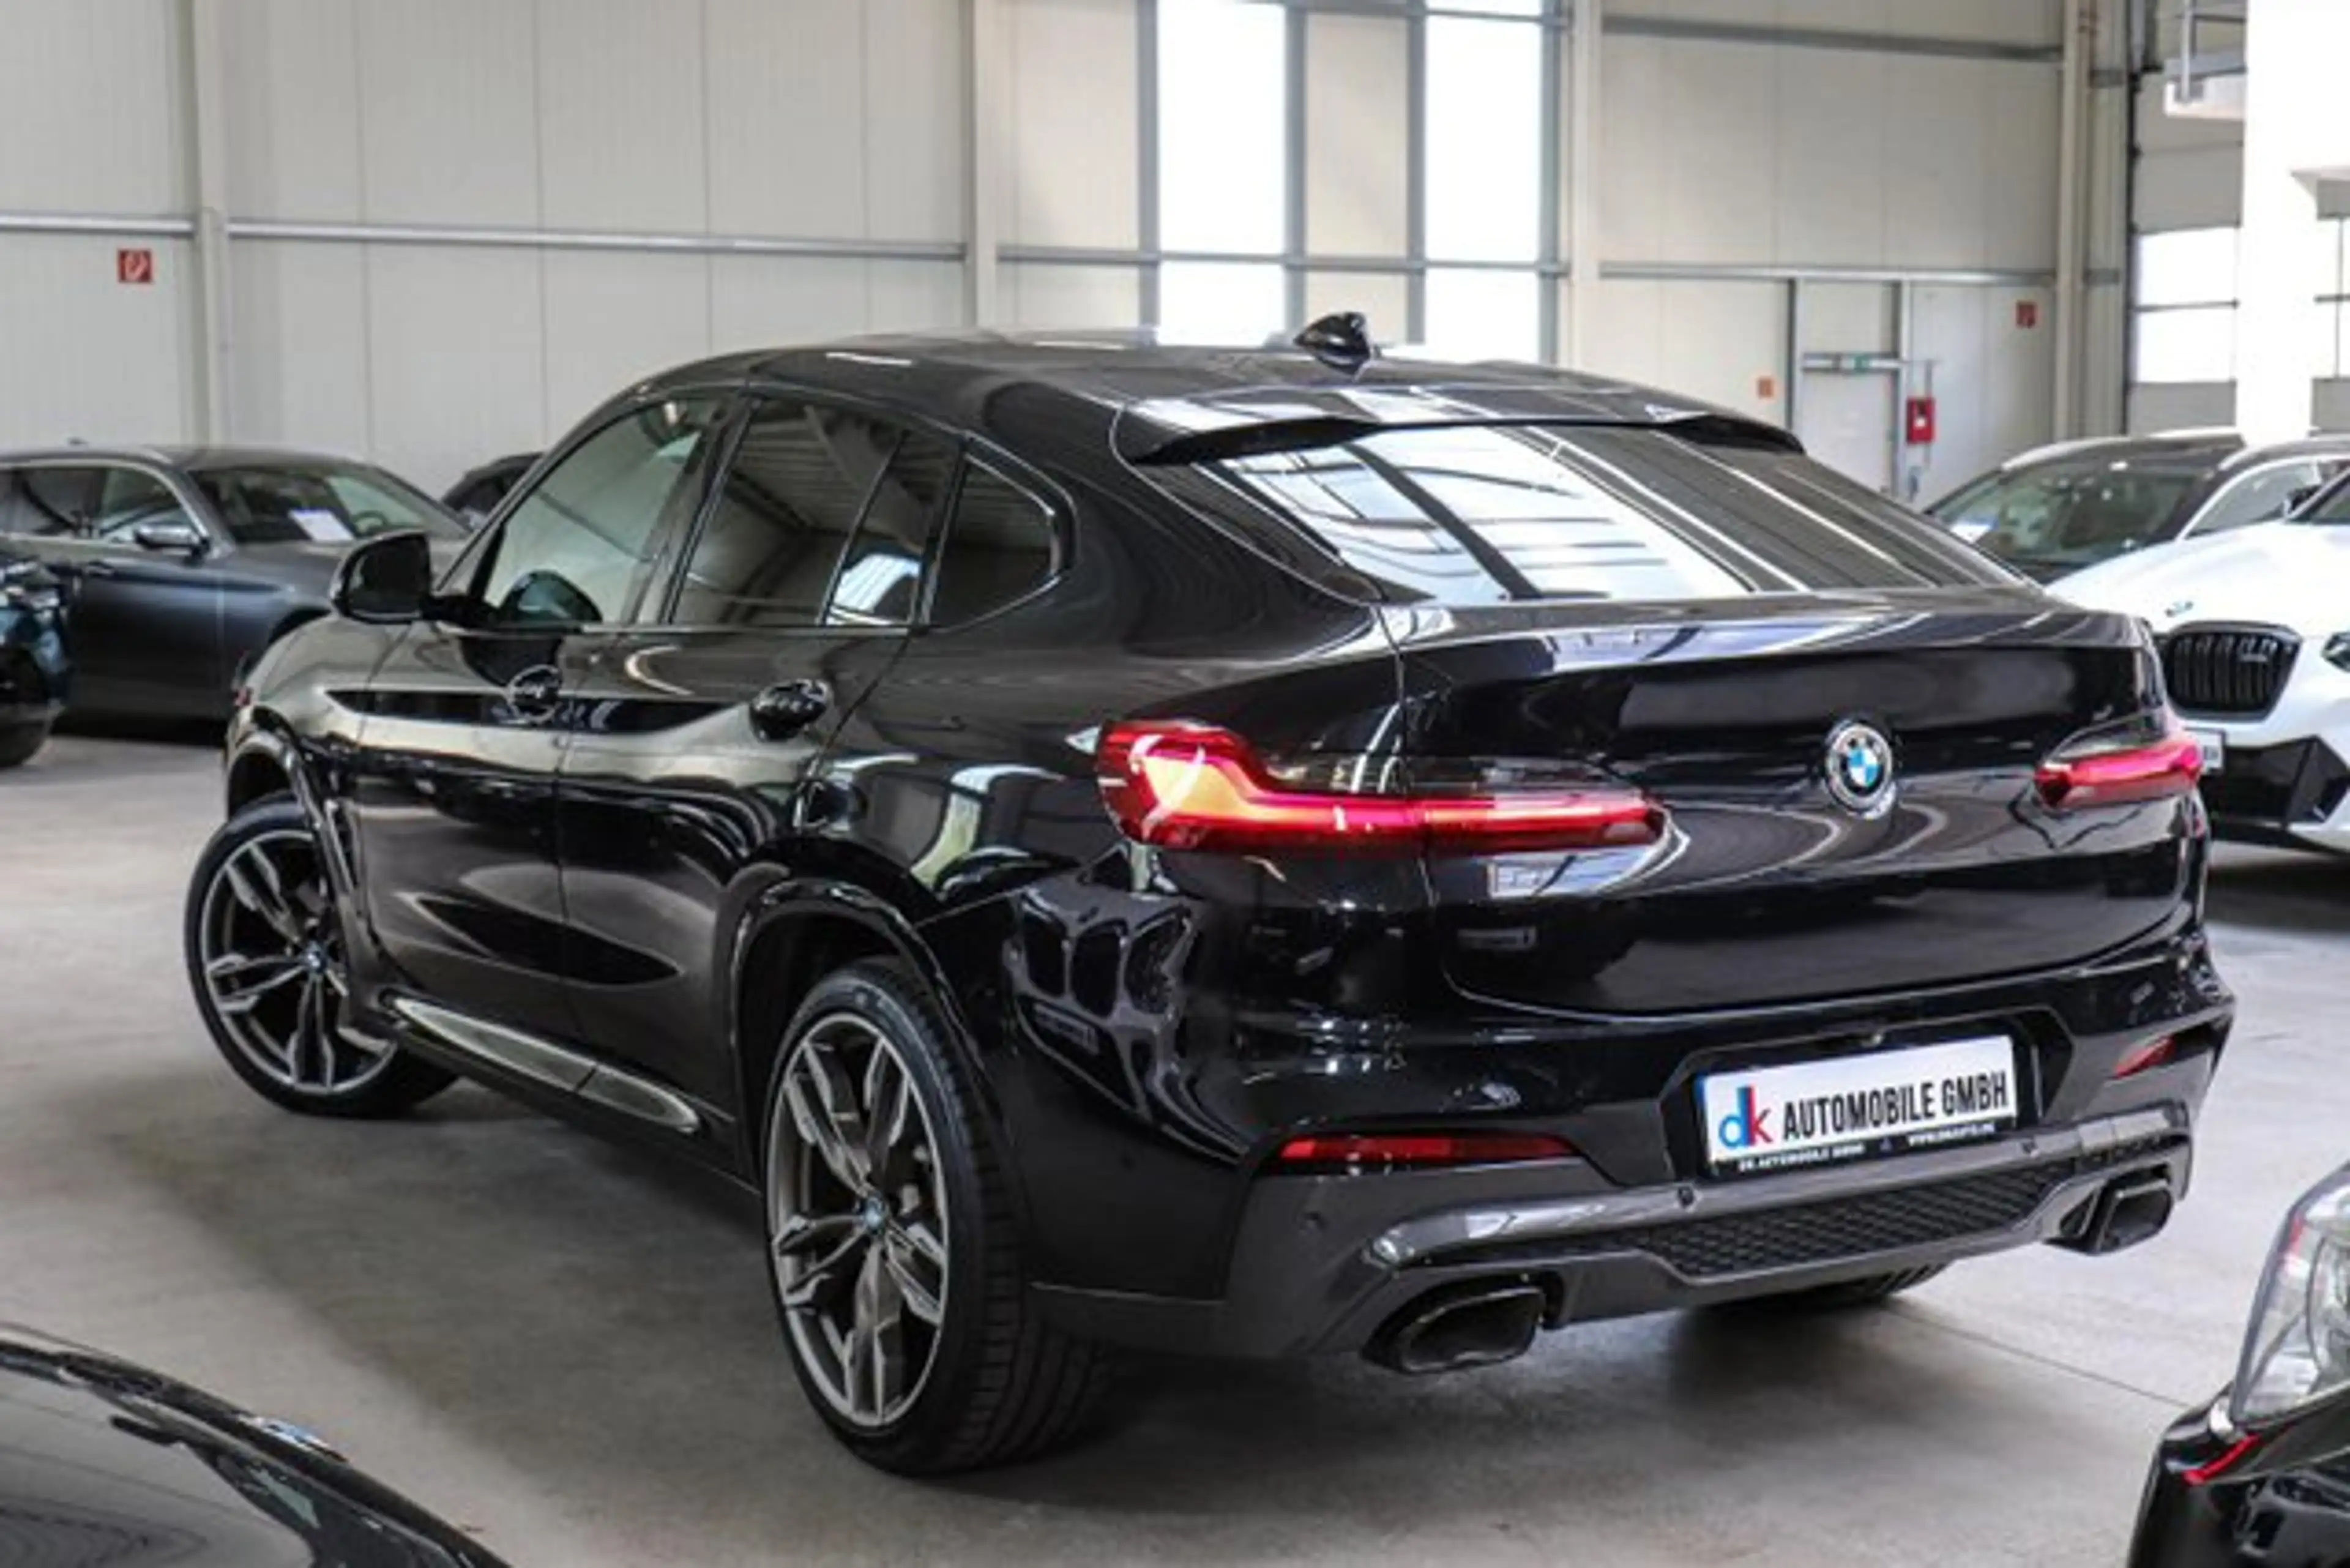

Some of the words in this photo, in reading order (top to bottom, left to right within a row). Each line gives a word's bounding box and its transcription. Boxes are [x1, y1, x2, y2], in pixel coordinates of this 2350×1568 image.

[1718, 1086, 1773, 1148] dk
[1783, 1082, 1936, 1140] AUTOMOBILE
[1941, 1071, 2007, 1117] GMBH
